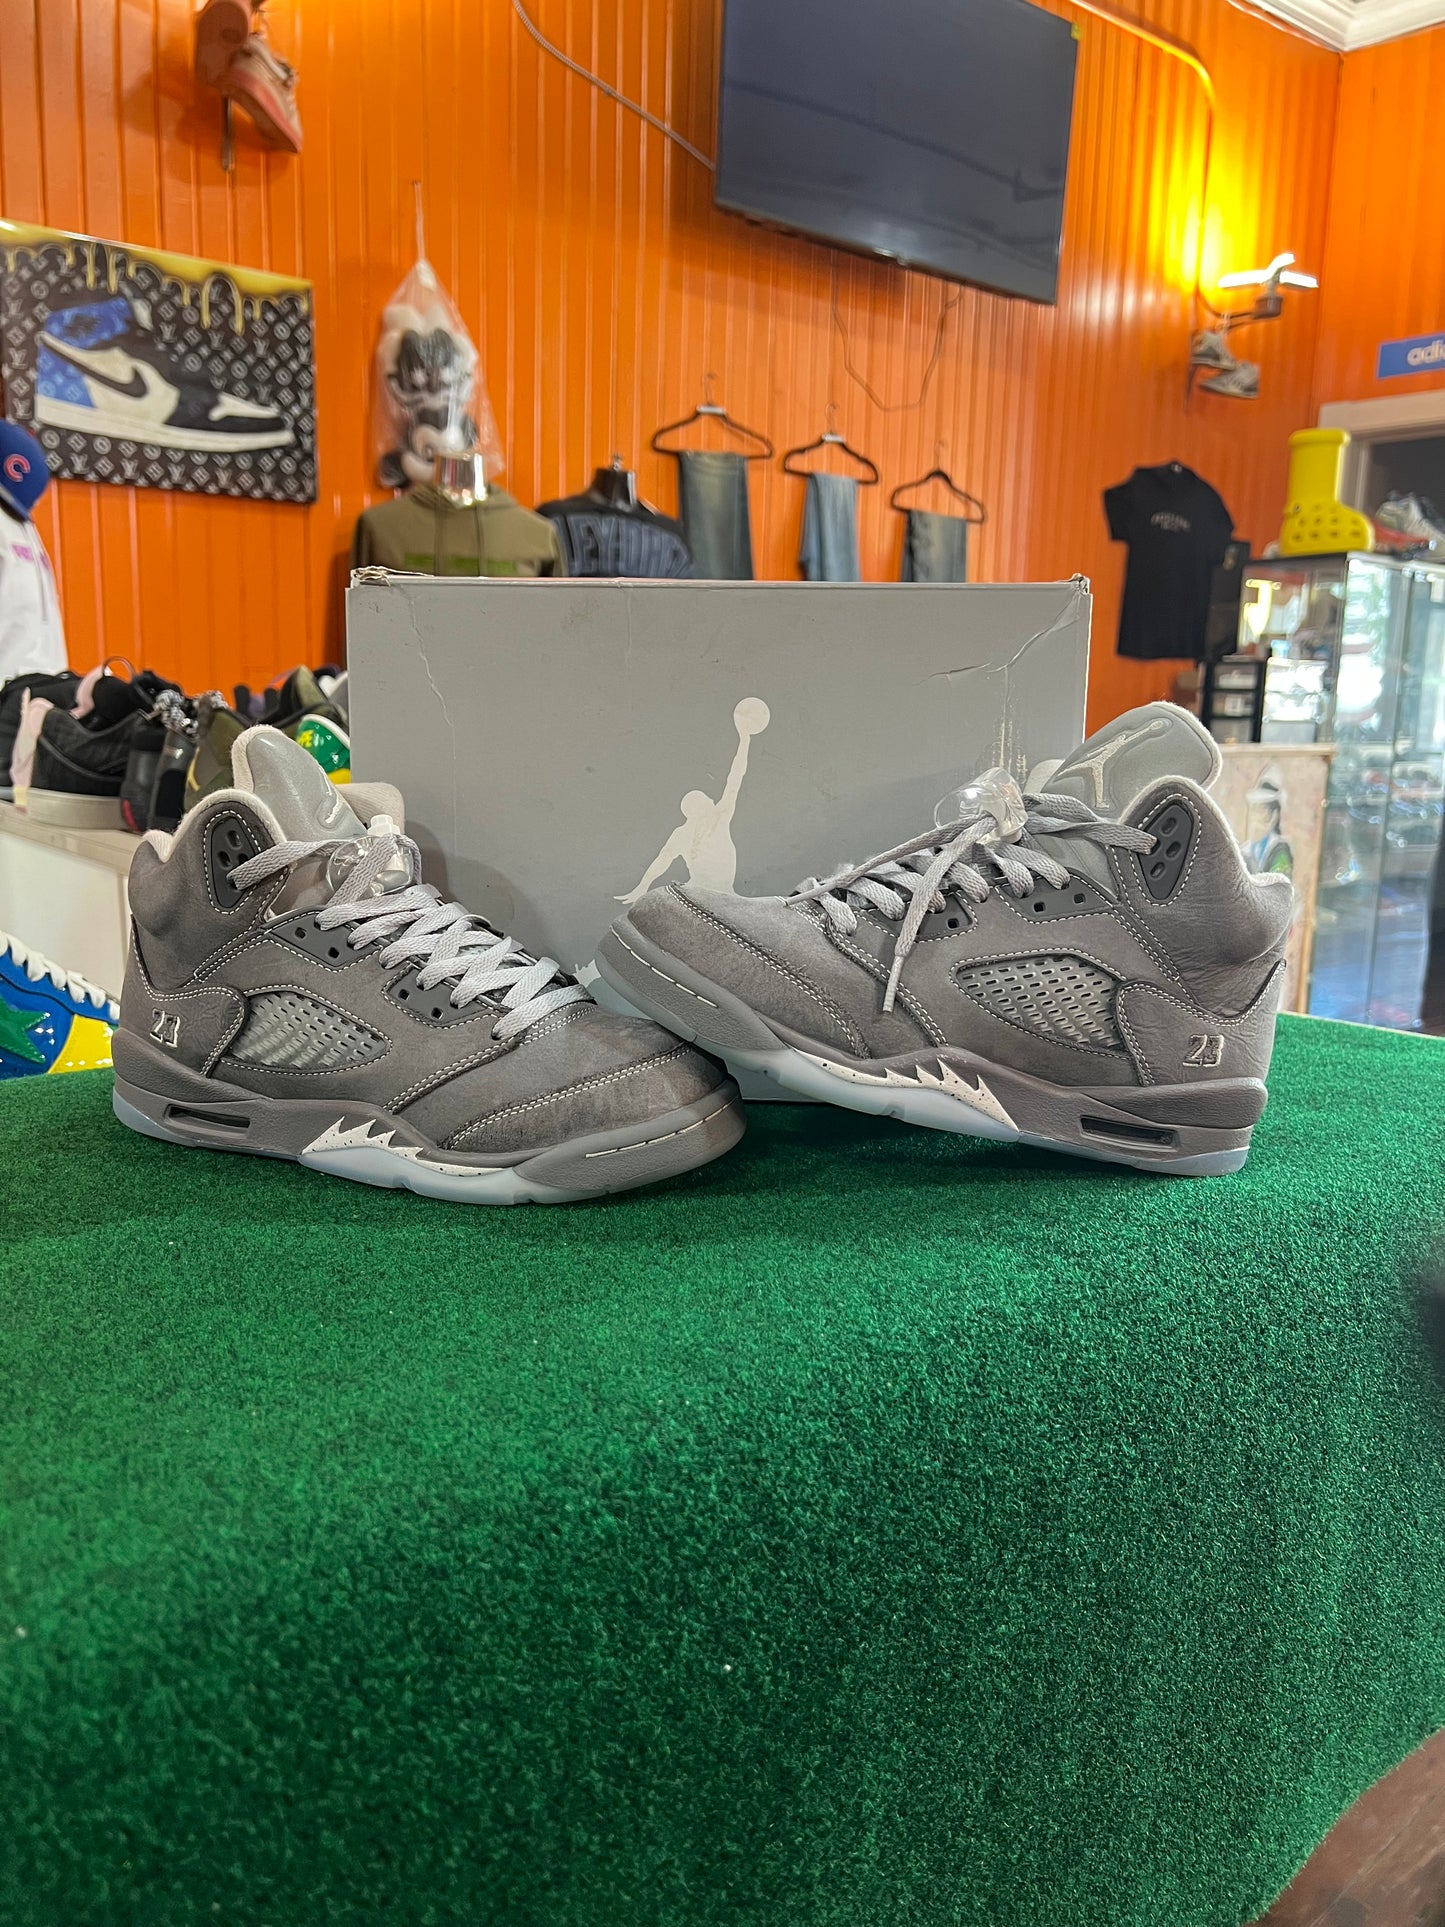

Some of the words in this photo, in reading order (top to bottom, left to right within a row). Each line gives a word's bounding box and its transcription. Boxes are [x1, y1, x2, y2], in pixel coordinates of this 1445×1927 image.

[3, 453, 31, 482] C
[149, 1008, 181, 1048] 23
[1182, 1034, 1224, 1067] 23
